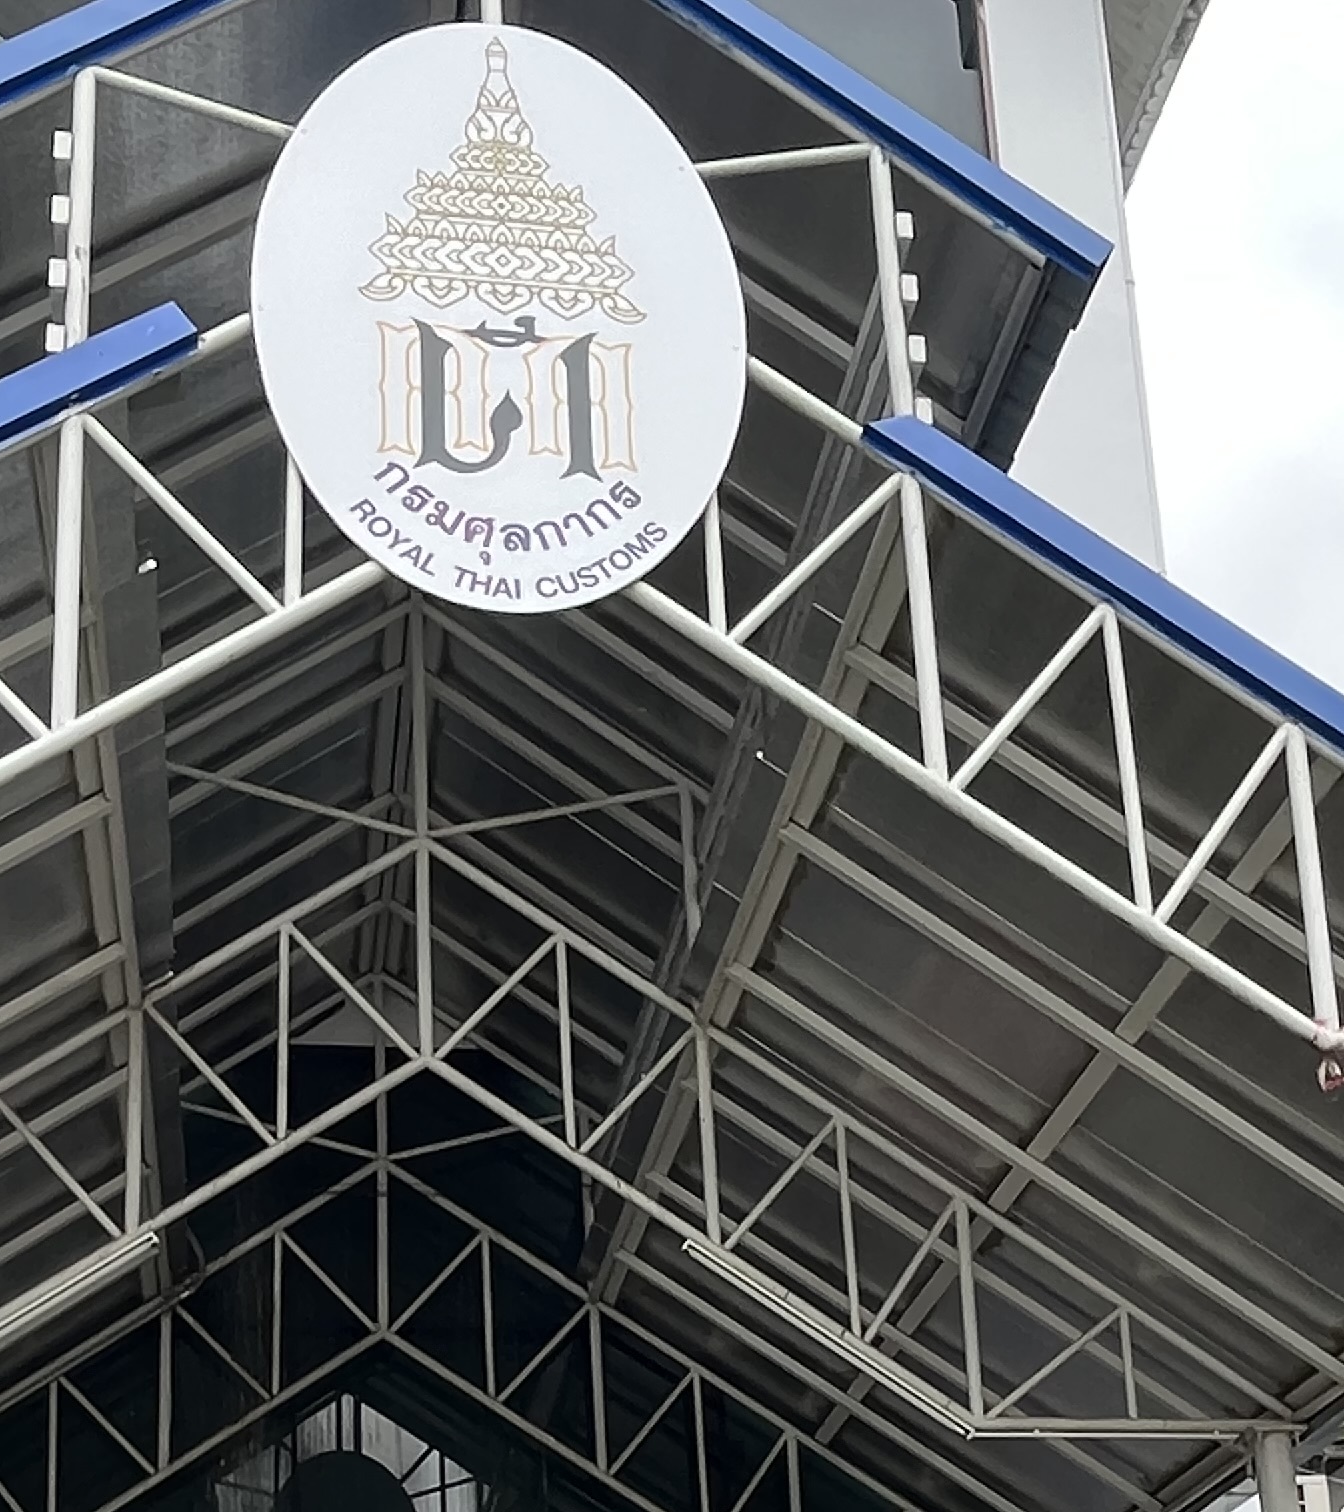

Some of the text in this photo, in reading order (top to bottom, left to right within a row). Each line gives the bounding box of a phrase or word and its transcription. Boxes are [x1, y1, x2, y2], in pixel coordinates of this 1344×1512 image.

[349, 498, 669, 600] ROYAL THAI CUSTOMS
[373, 461, 643, 566] กรมศุลกากร
